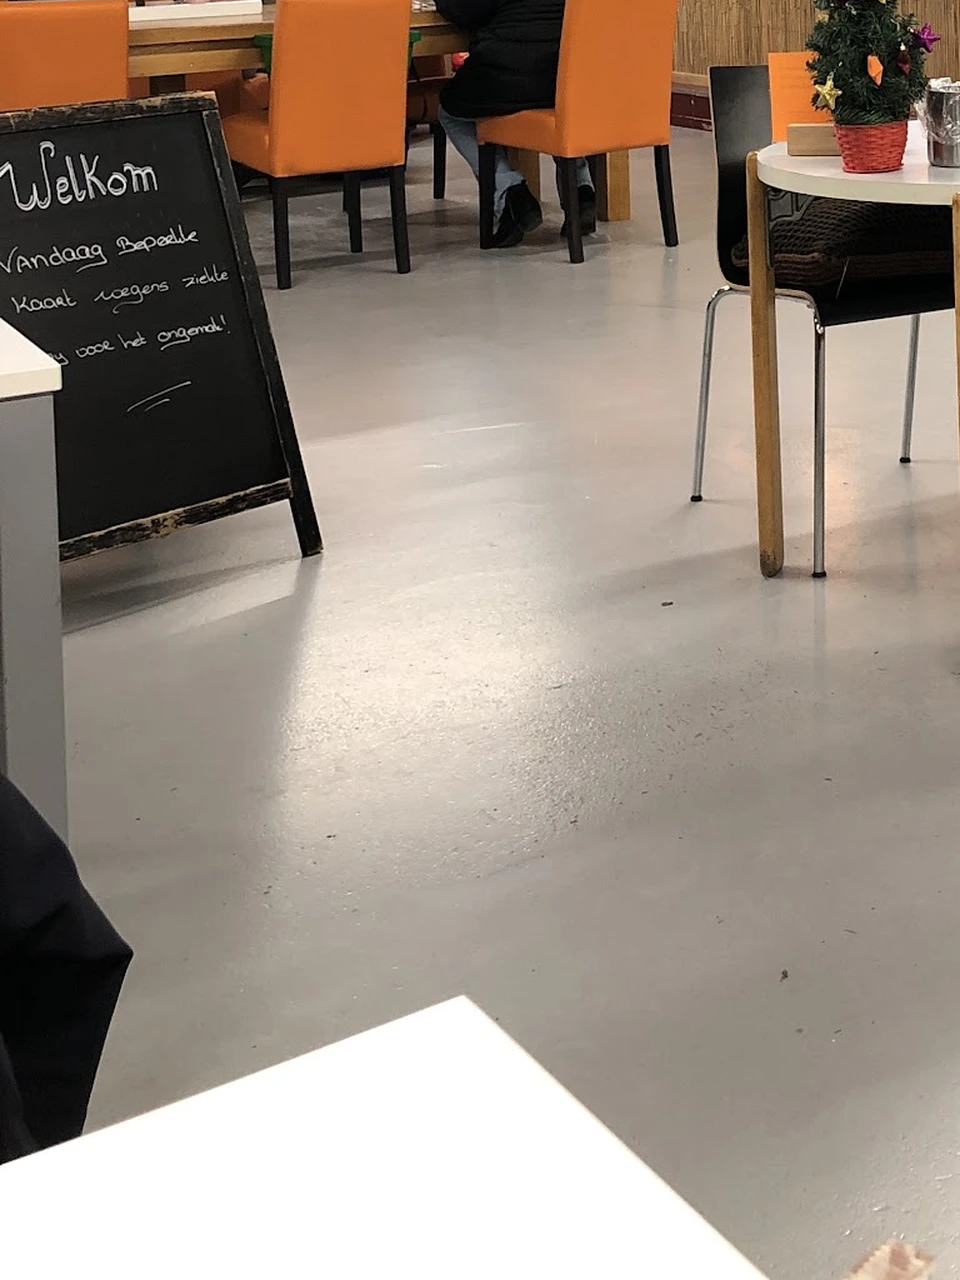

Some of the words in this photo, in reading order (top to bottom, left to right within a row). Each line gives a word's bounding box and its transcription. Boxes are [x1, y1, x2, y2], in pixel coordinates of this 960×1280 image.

[11, 288, 77, 314] Kaart
[93, 280, 169, 314] wegens
[117, 331, 147, 350] het
